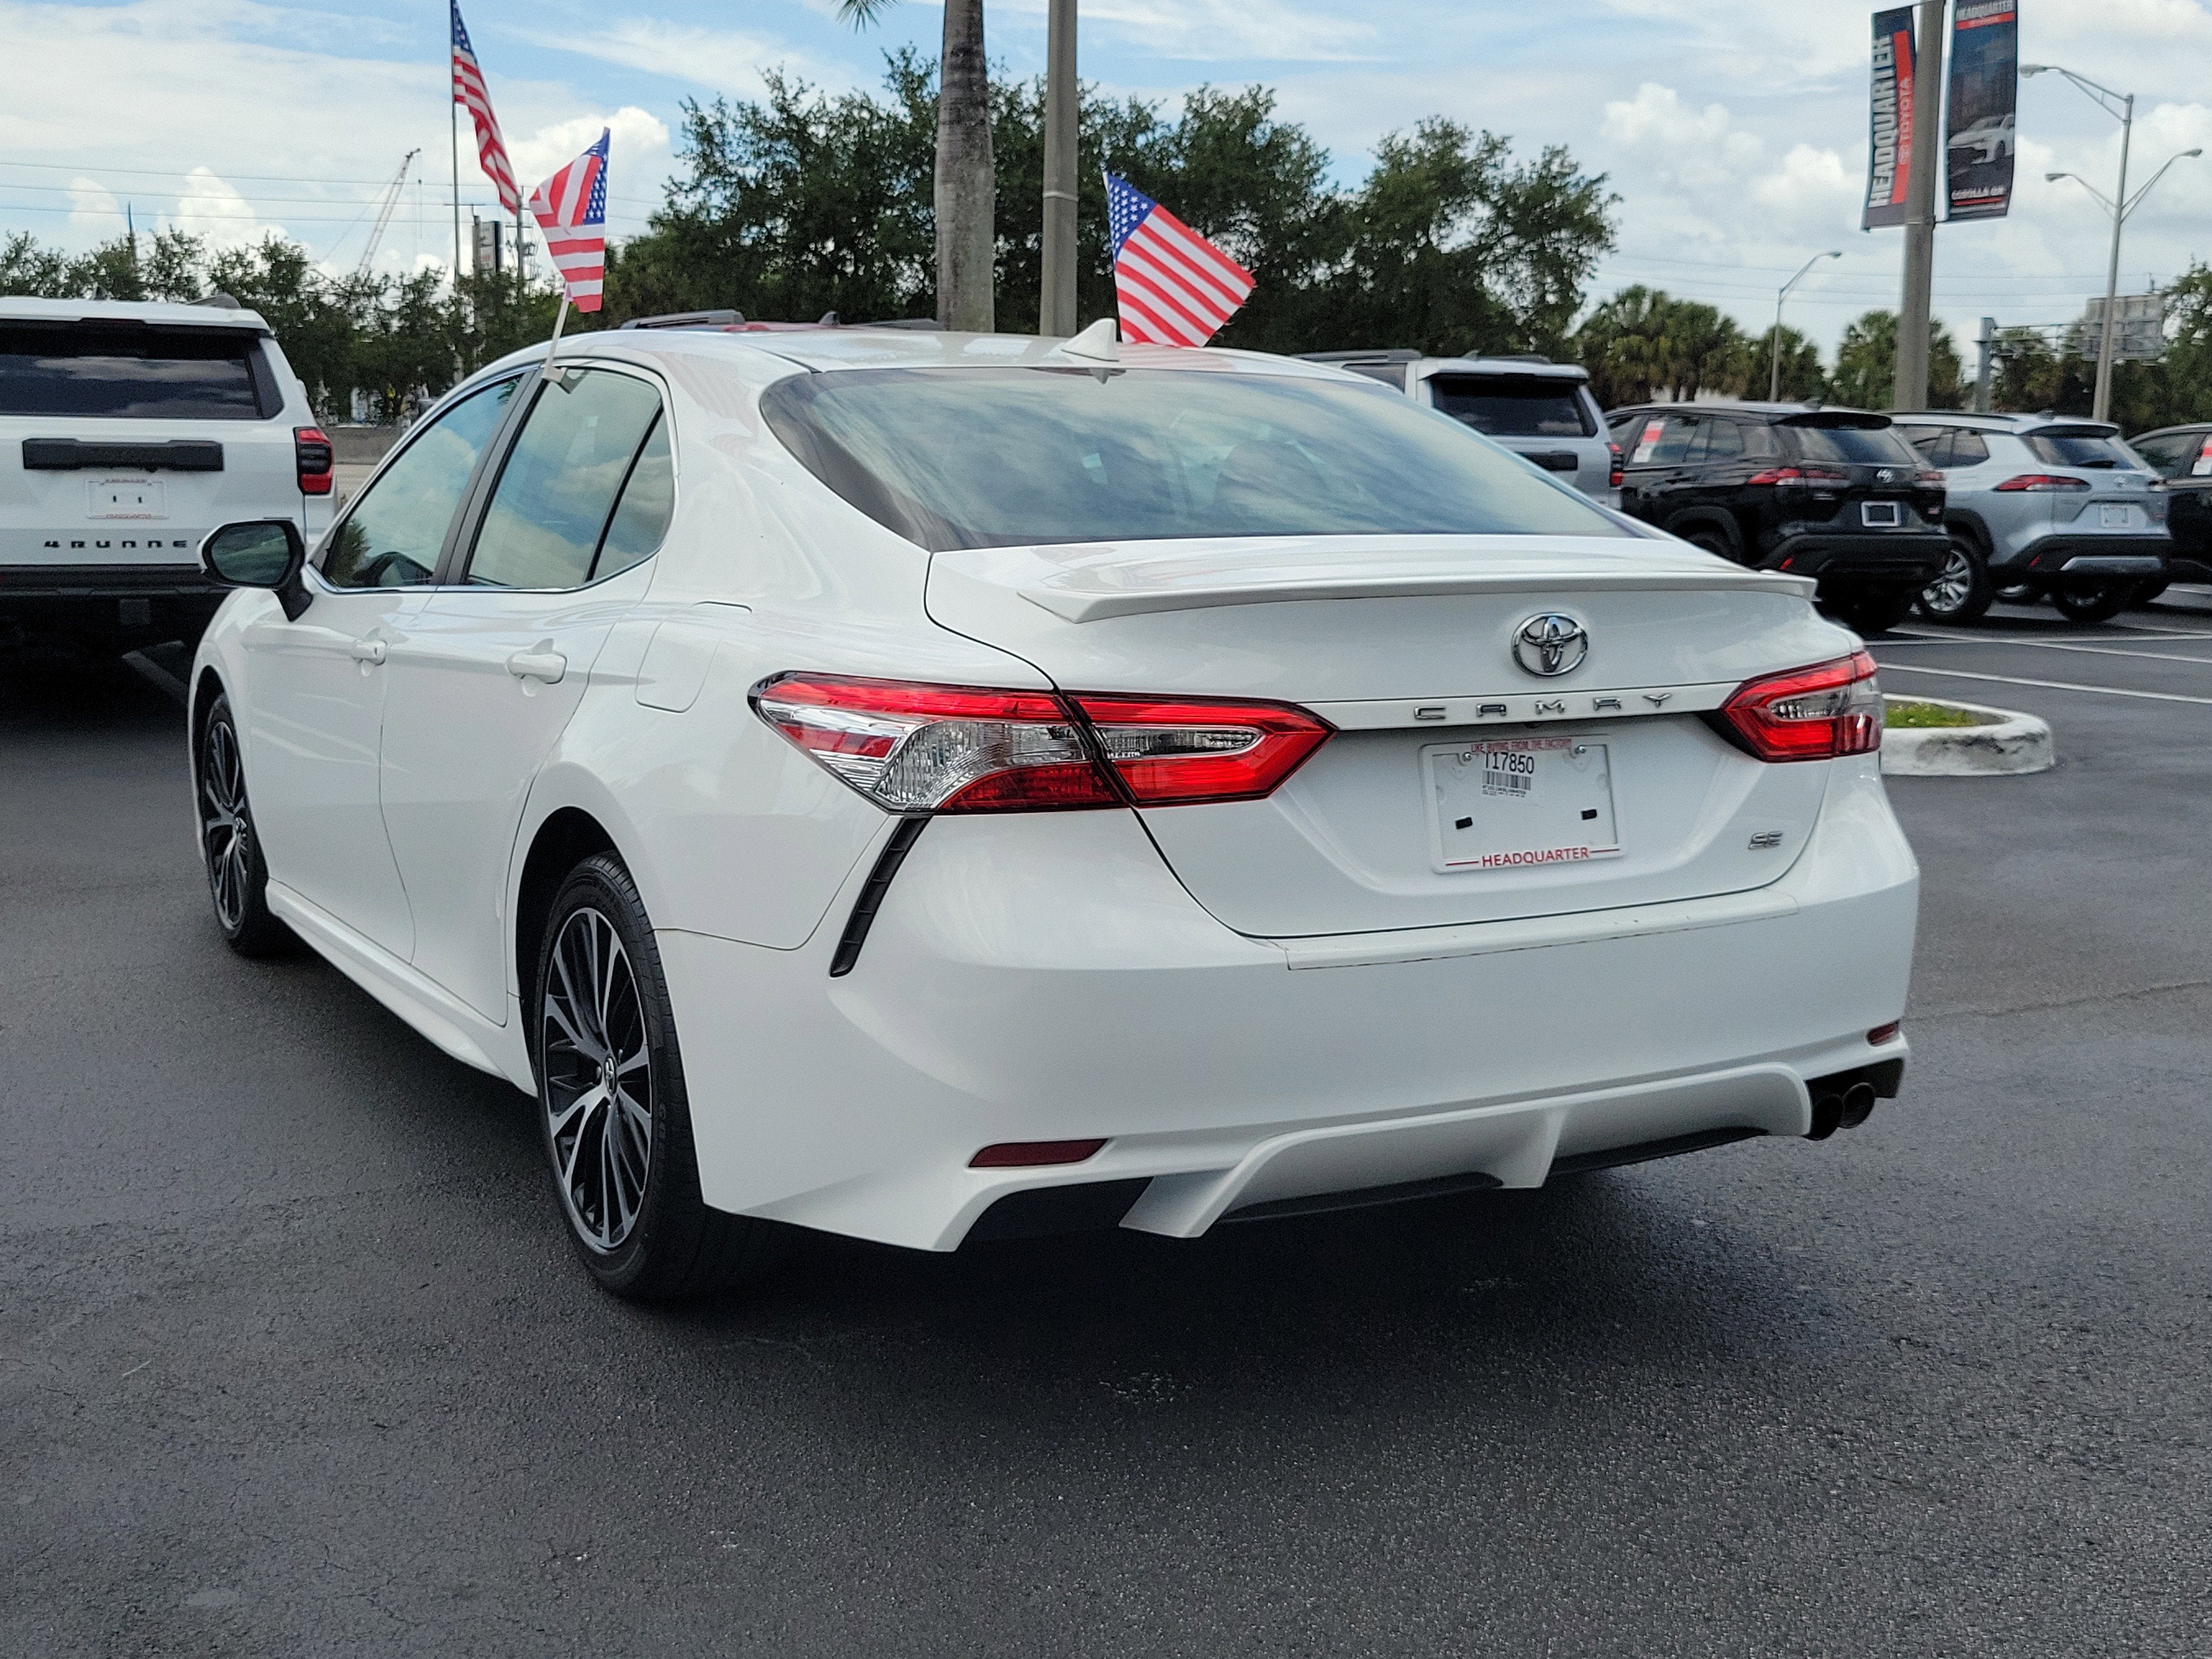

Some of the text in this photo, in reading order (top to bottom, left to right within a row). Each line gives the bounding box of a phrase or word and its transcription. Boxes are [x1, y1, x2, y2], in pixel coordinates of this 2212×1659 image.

[1899, 76, 1913, 142] TOYOTA
[1867, 35, 1897, 207] HEADQUARTER
[44, 540, 201, 549] 4RUNNE
[1413, 693, 1672, 720] CAMRY
[1748, 831, 1783, 850] SE
[1482, 847, 1589, 867] HEADQUARTER
